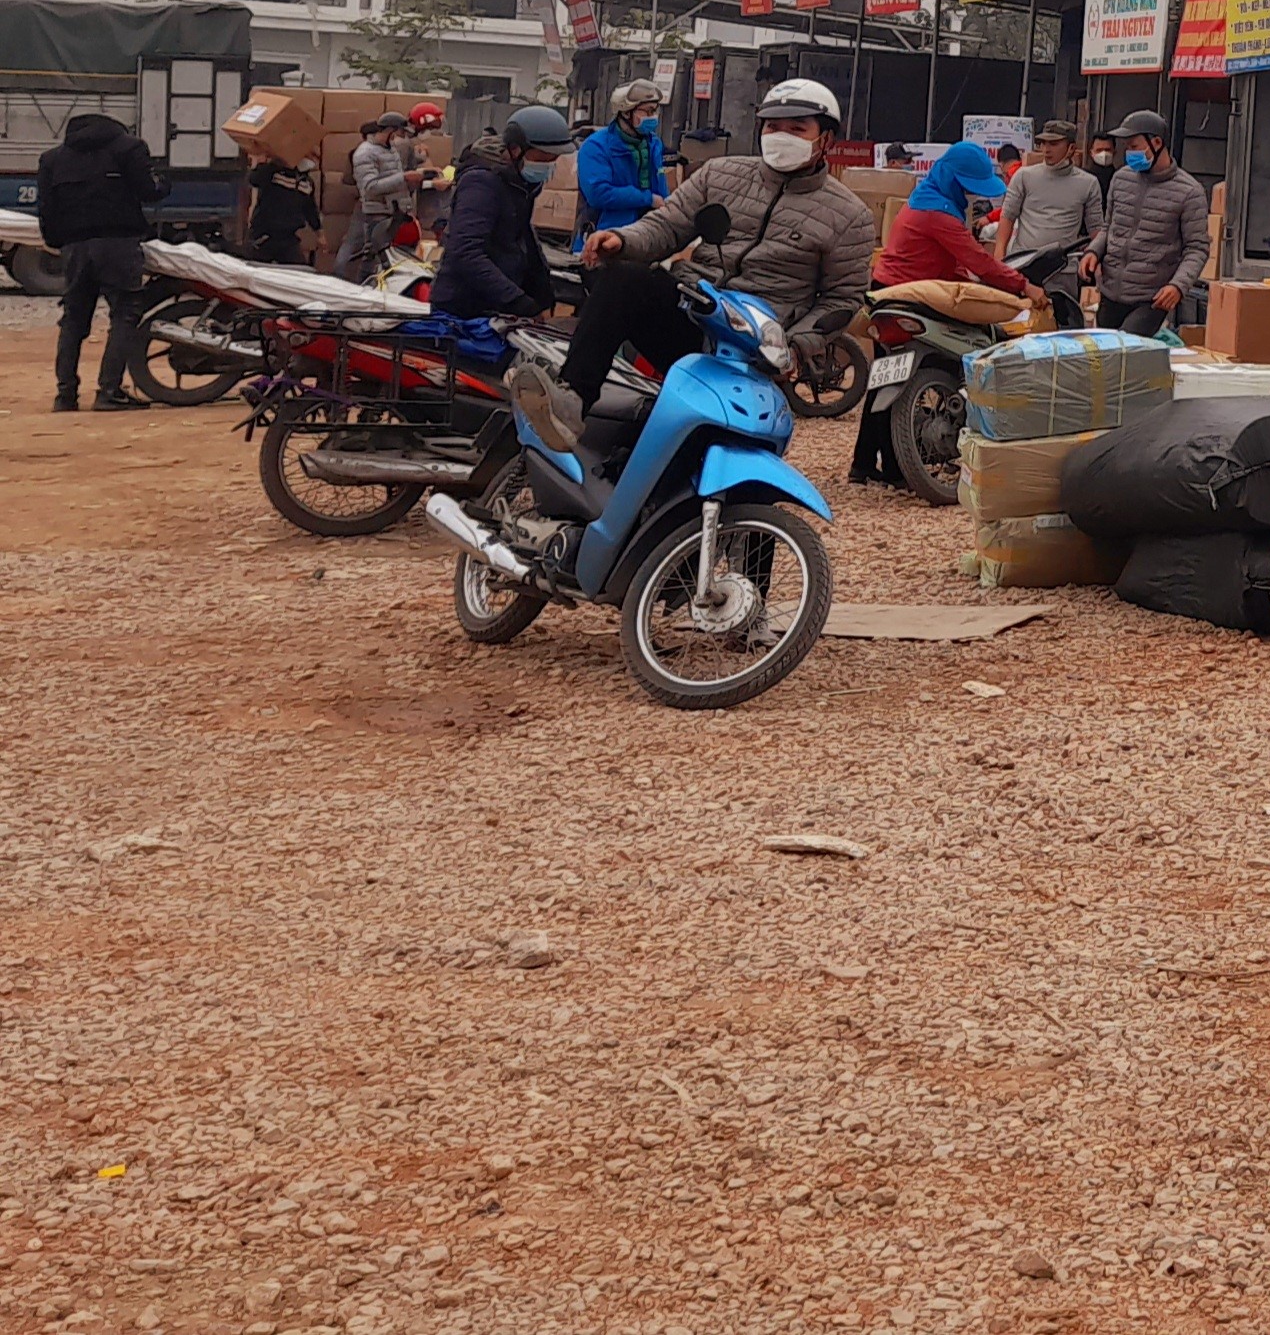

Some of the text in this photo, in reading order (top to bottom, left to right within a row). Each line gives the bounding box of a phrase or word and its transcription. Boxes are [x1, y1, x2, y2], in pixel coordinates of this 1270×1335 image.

[1102, 12, 1155, 39] THÁI NGUYÊN
[18, 186, 37, 203] 29
